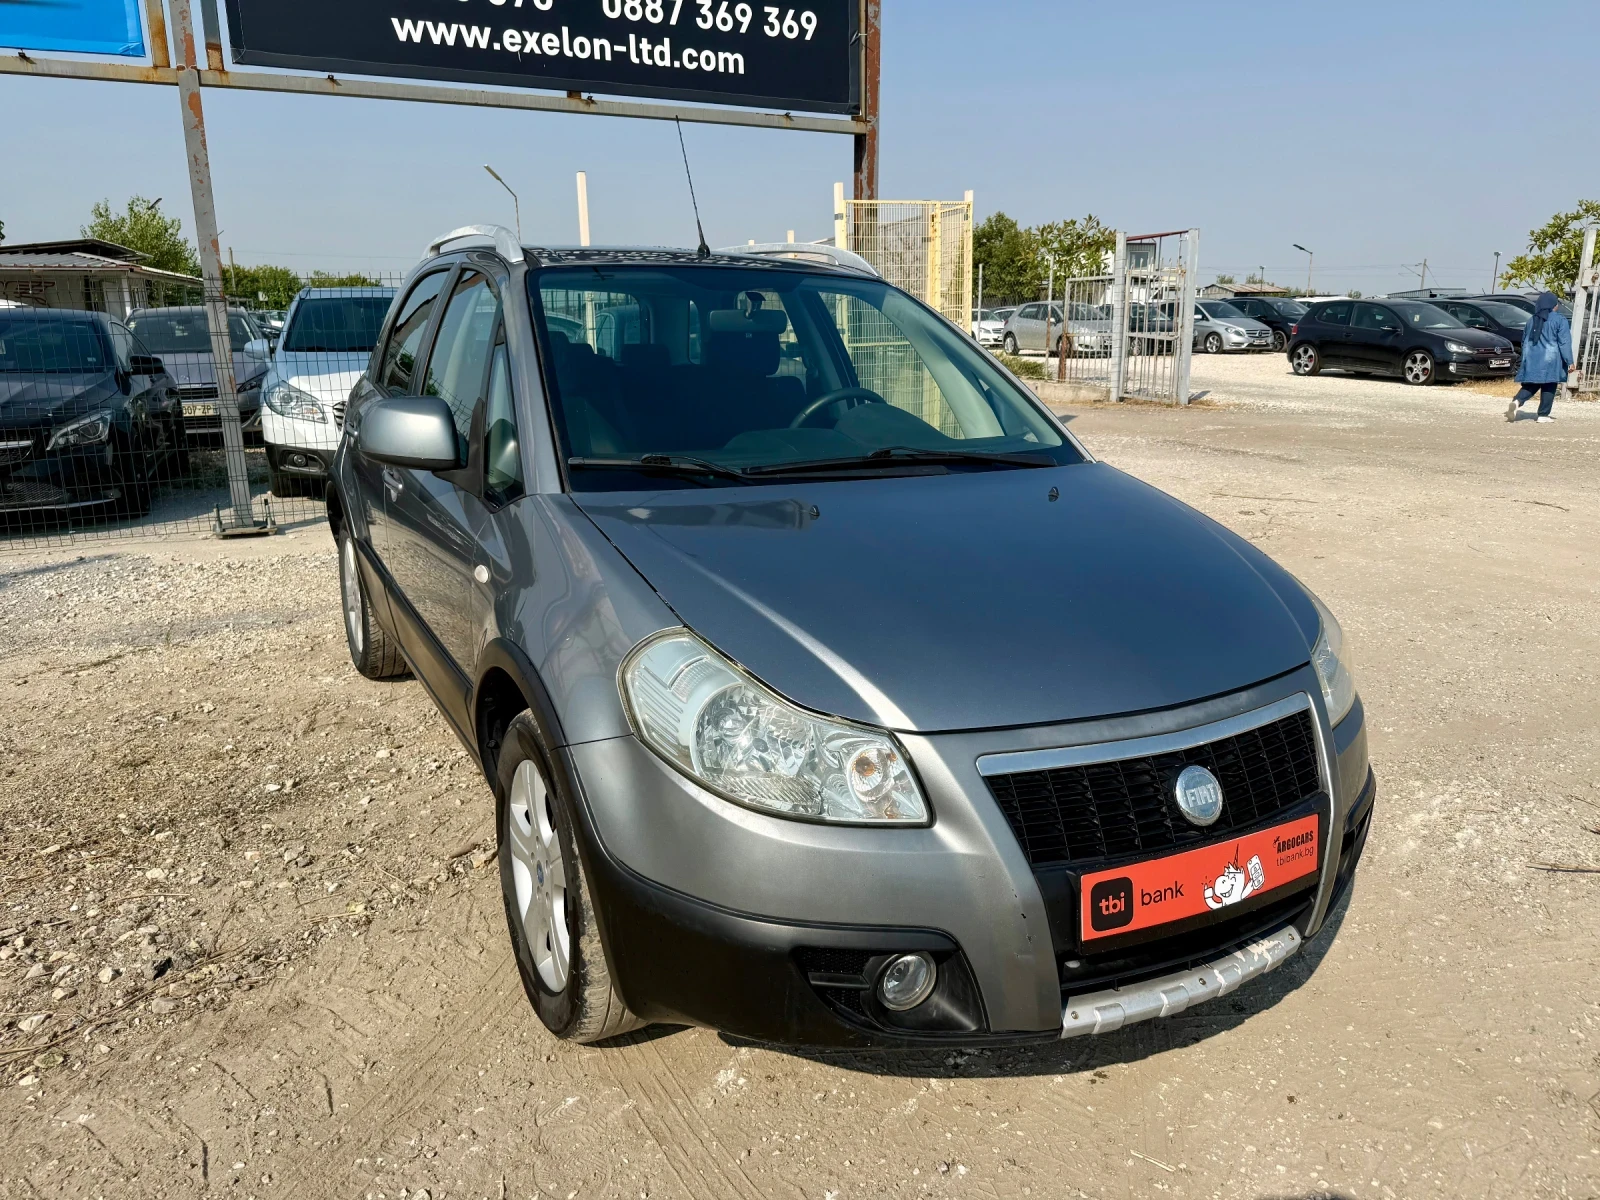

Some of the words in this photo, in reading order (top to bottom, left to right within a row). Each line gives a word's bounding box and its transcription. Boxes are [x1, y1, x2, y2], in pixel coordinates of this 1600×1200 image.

[602, 0, 683, 26] 0887
[695, 0, 752, 34] 369
[763, 6, 818, 41] 369
[391, 17, 745, 75] www.exelon-ltd.com
[1185, 783, 1217, 808] FIAT
[1276, 846, 1314, 867] tbibank.bg
[1277, 830, 1314, 854] ARGOCARS
[1099, 891, 1125, 915] tbi
[1141, 881, 1184, 906] bank
